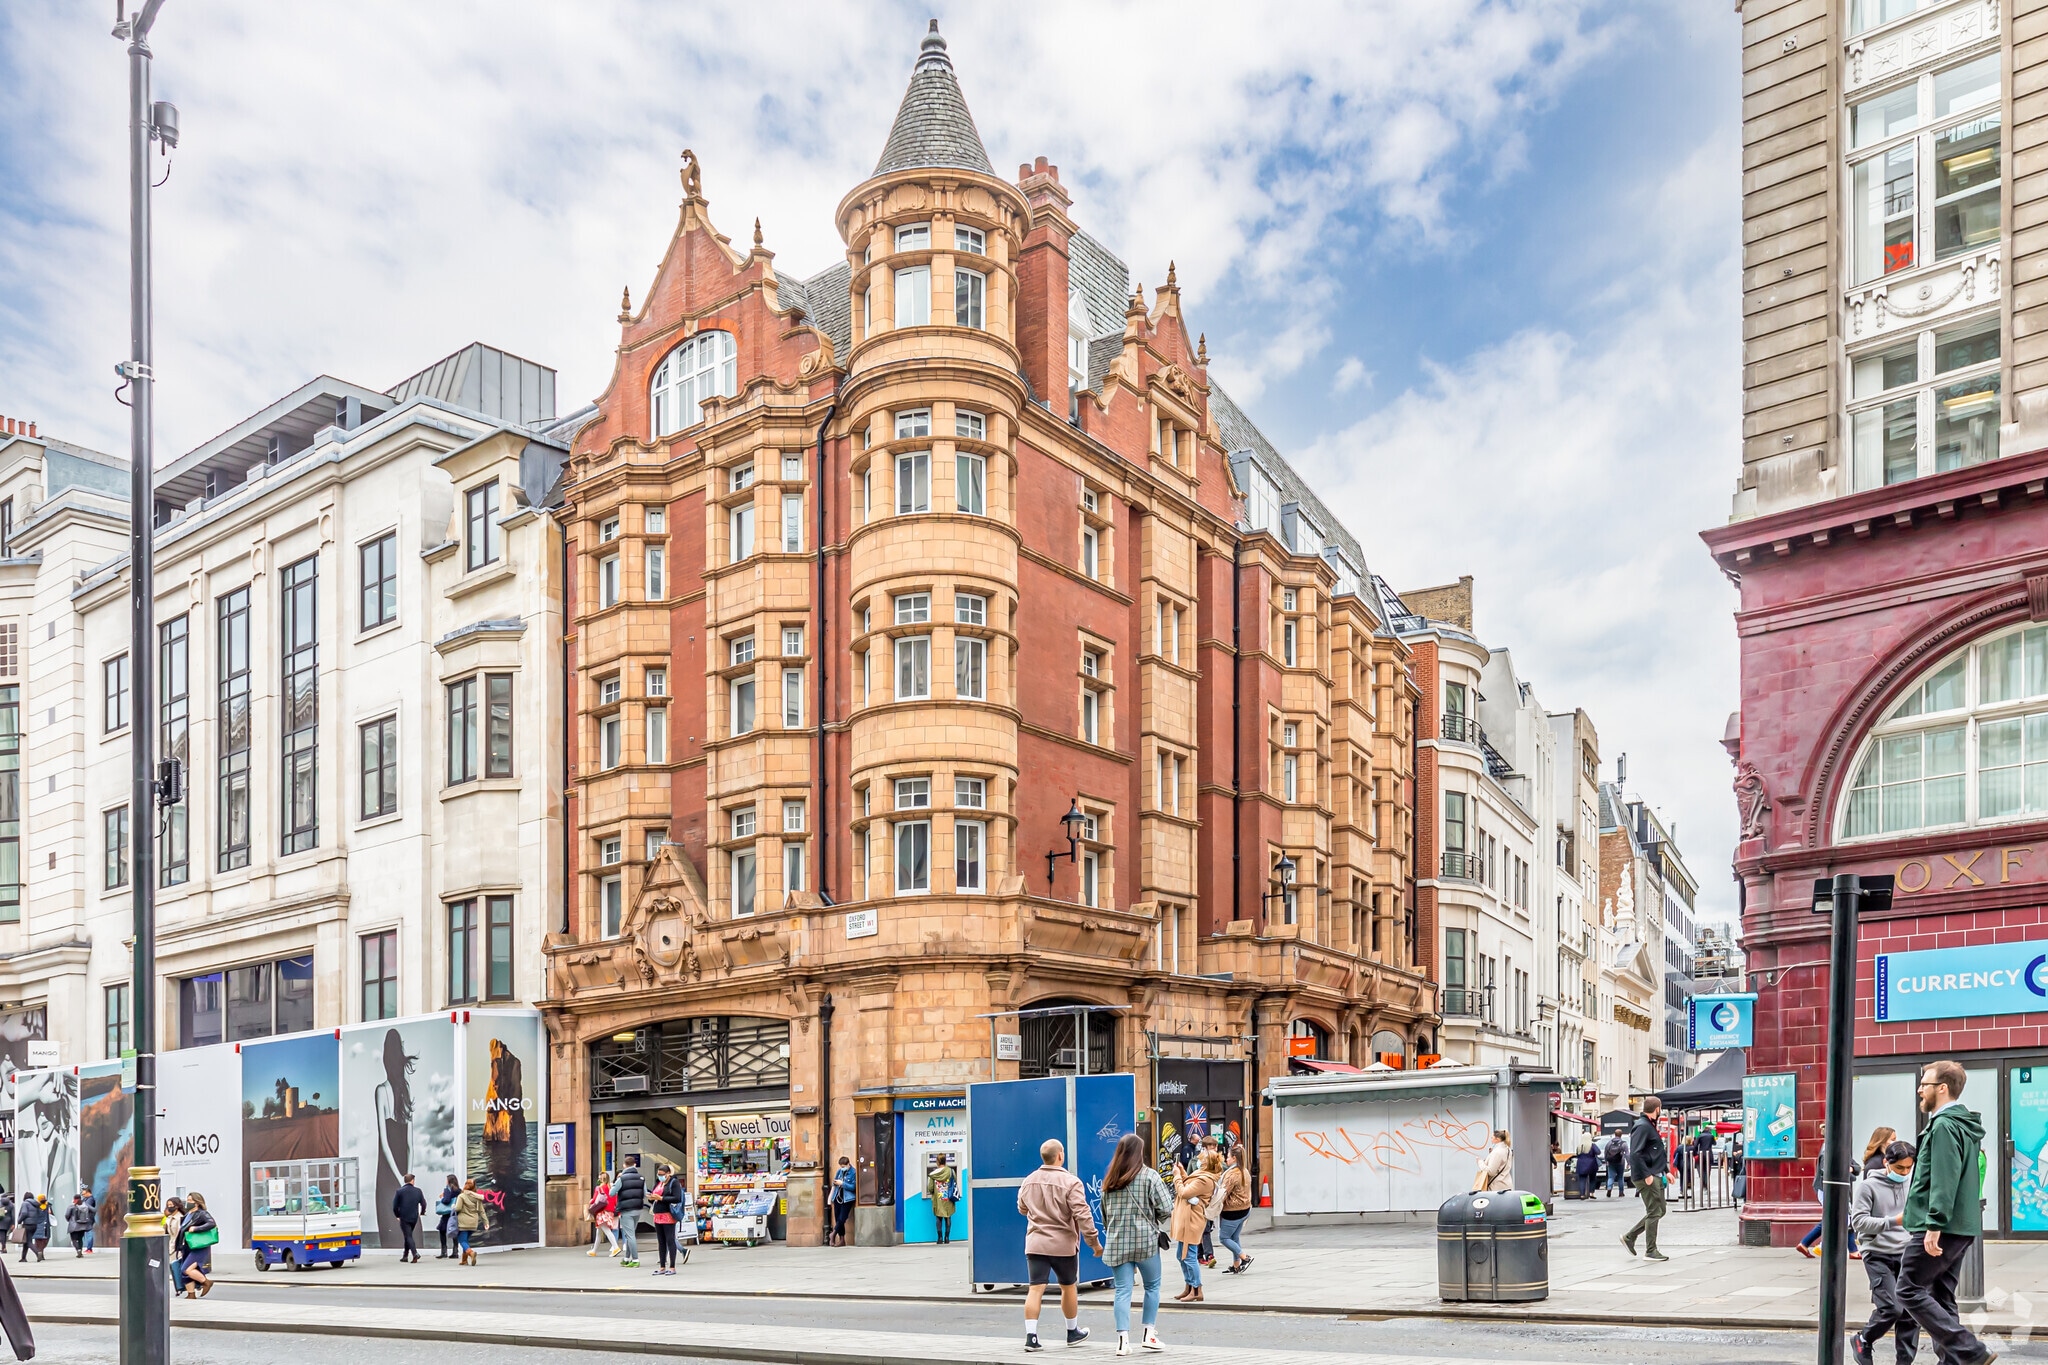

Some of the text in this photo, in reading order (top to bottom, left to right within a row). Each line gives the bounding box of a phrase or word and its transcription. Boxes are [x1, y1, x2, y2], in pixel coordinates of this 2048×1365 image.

[849, 914, 866, 922] OXFORD
[849, 921, 865, 930] STREET
[1897, 968, 2021, 994] CURRENCY
[1758, 1077, 1786, 1088] EASY
[472, 1097, 533, 1111] MANGO
[912, 1100, 936, 1108] CASH
[720, 1119, 761, 1136] Sweet
[927, 1116, 955, 1128] ATM
[163, 1133, 220, 1156] MANGO
